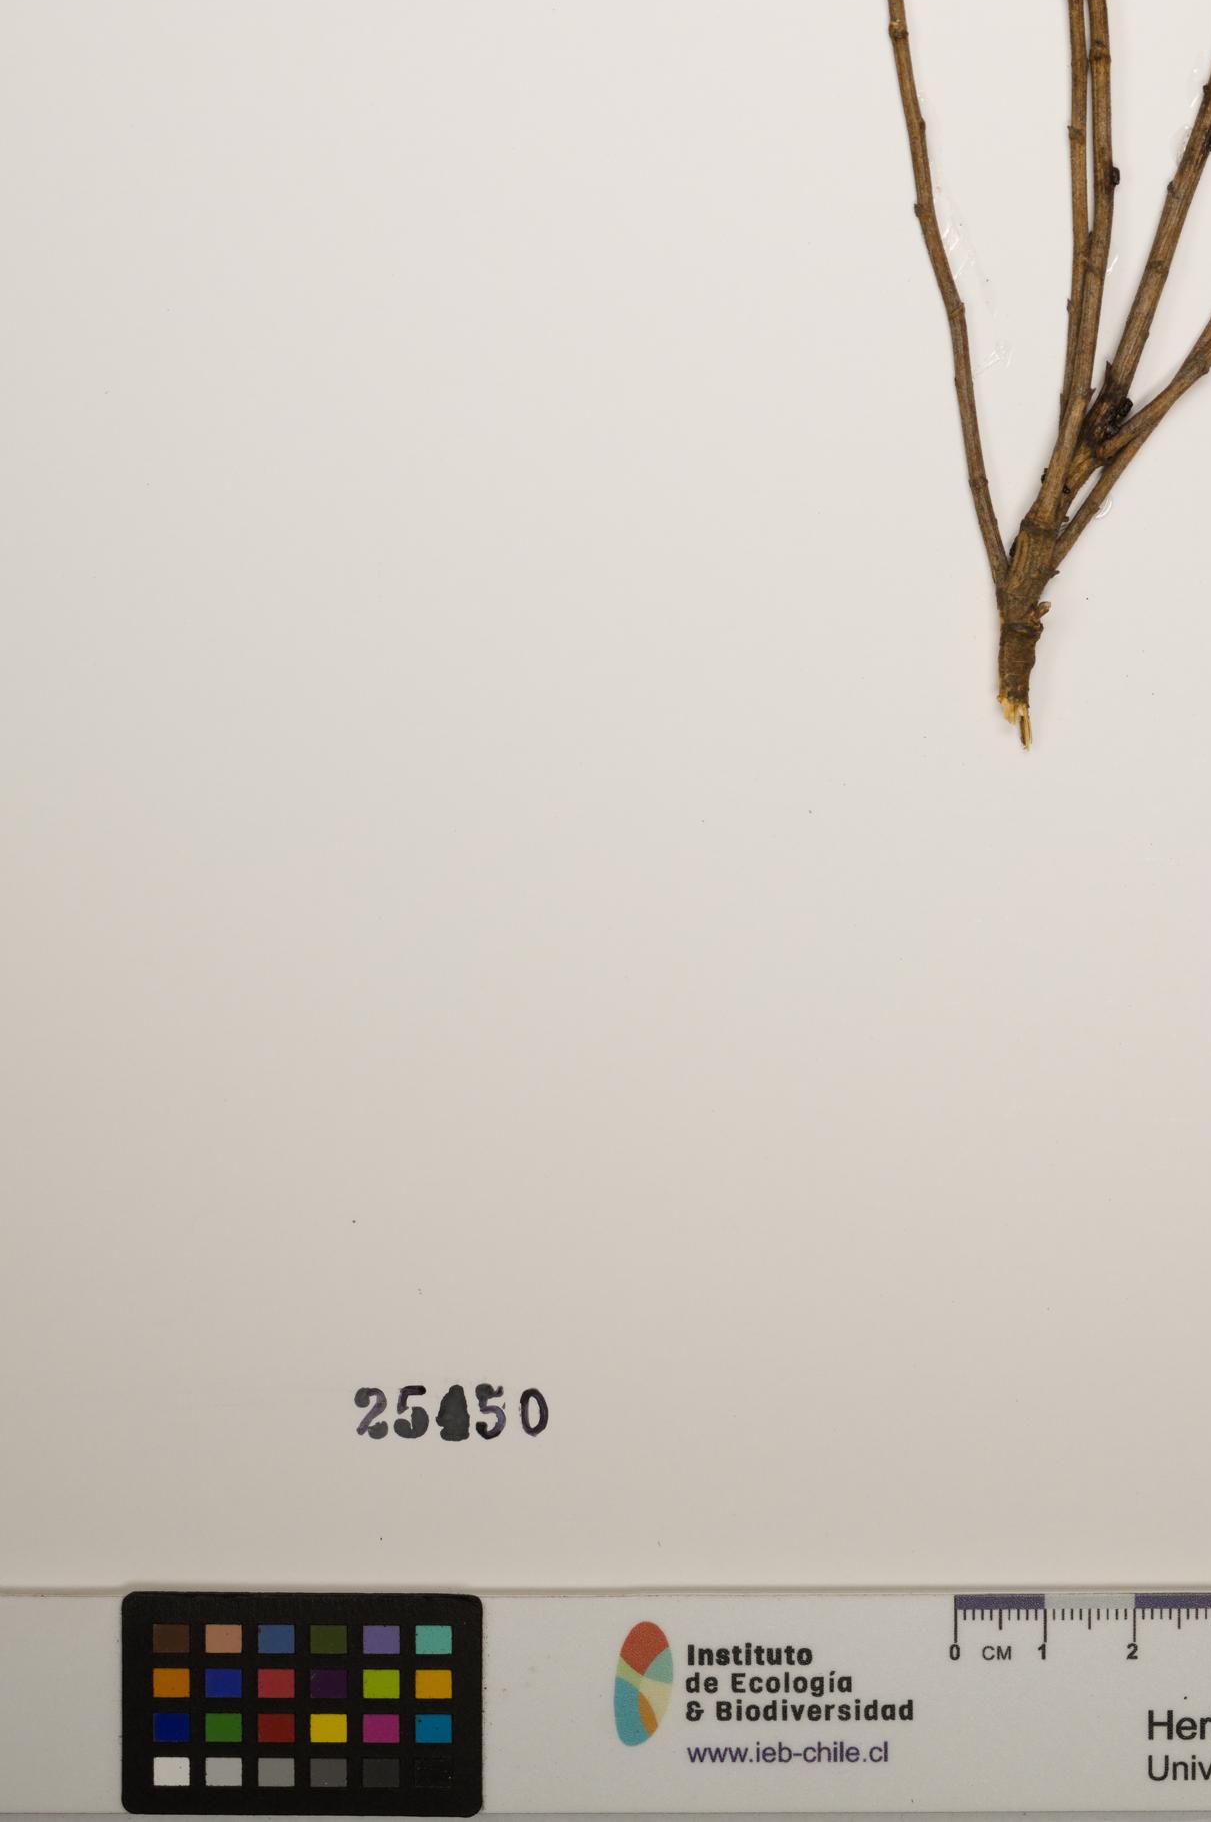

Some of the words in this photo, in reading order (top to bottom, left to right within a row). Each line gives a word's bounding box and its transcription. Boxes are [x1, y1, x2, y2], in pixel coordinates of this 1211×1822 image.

[687, 1641, 814, 1667] Instituto
[948, 1644, 961, 1662] 0
[981, 1645, 1012, 1661] CM
[1037, 1643, 1048, 1661] 1
[1125, 1643, 1139, 1661] 2
[685, 1671, 719, 1695] de
[730, 1670, 853, 1698] Ecología
[685, 1700, 705, 1723] &
[715, 1698, 914, 1722] Biodiversidad
[686, 1740, 889, 1764] www.ieb-chile.cl
